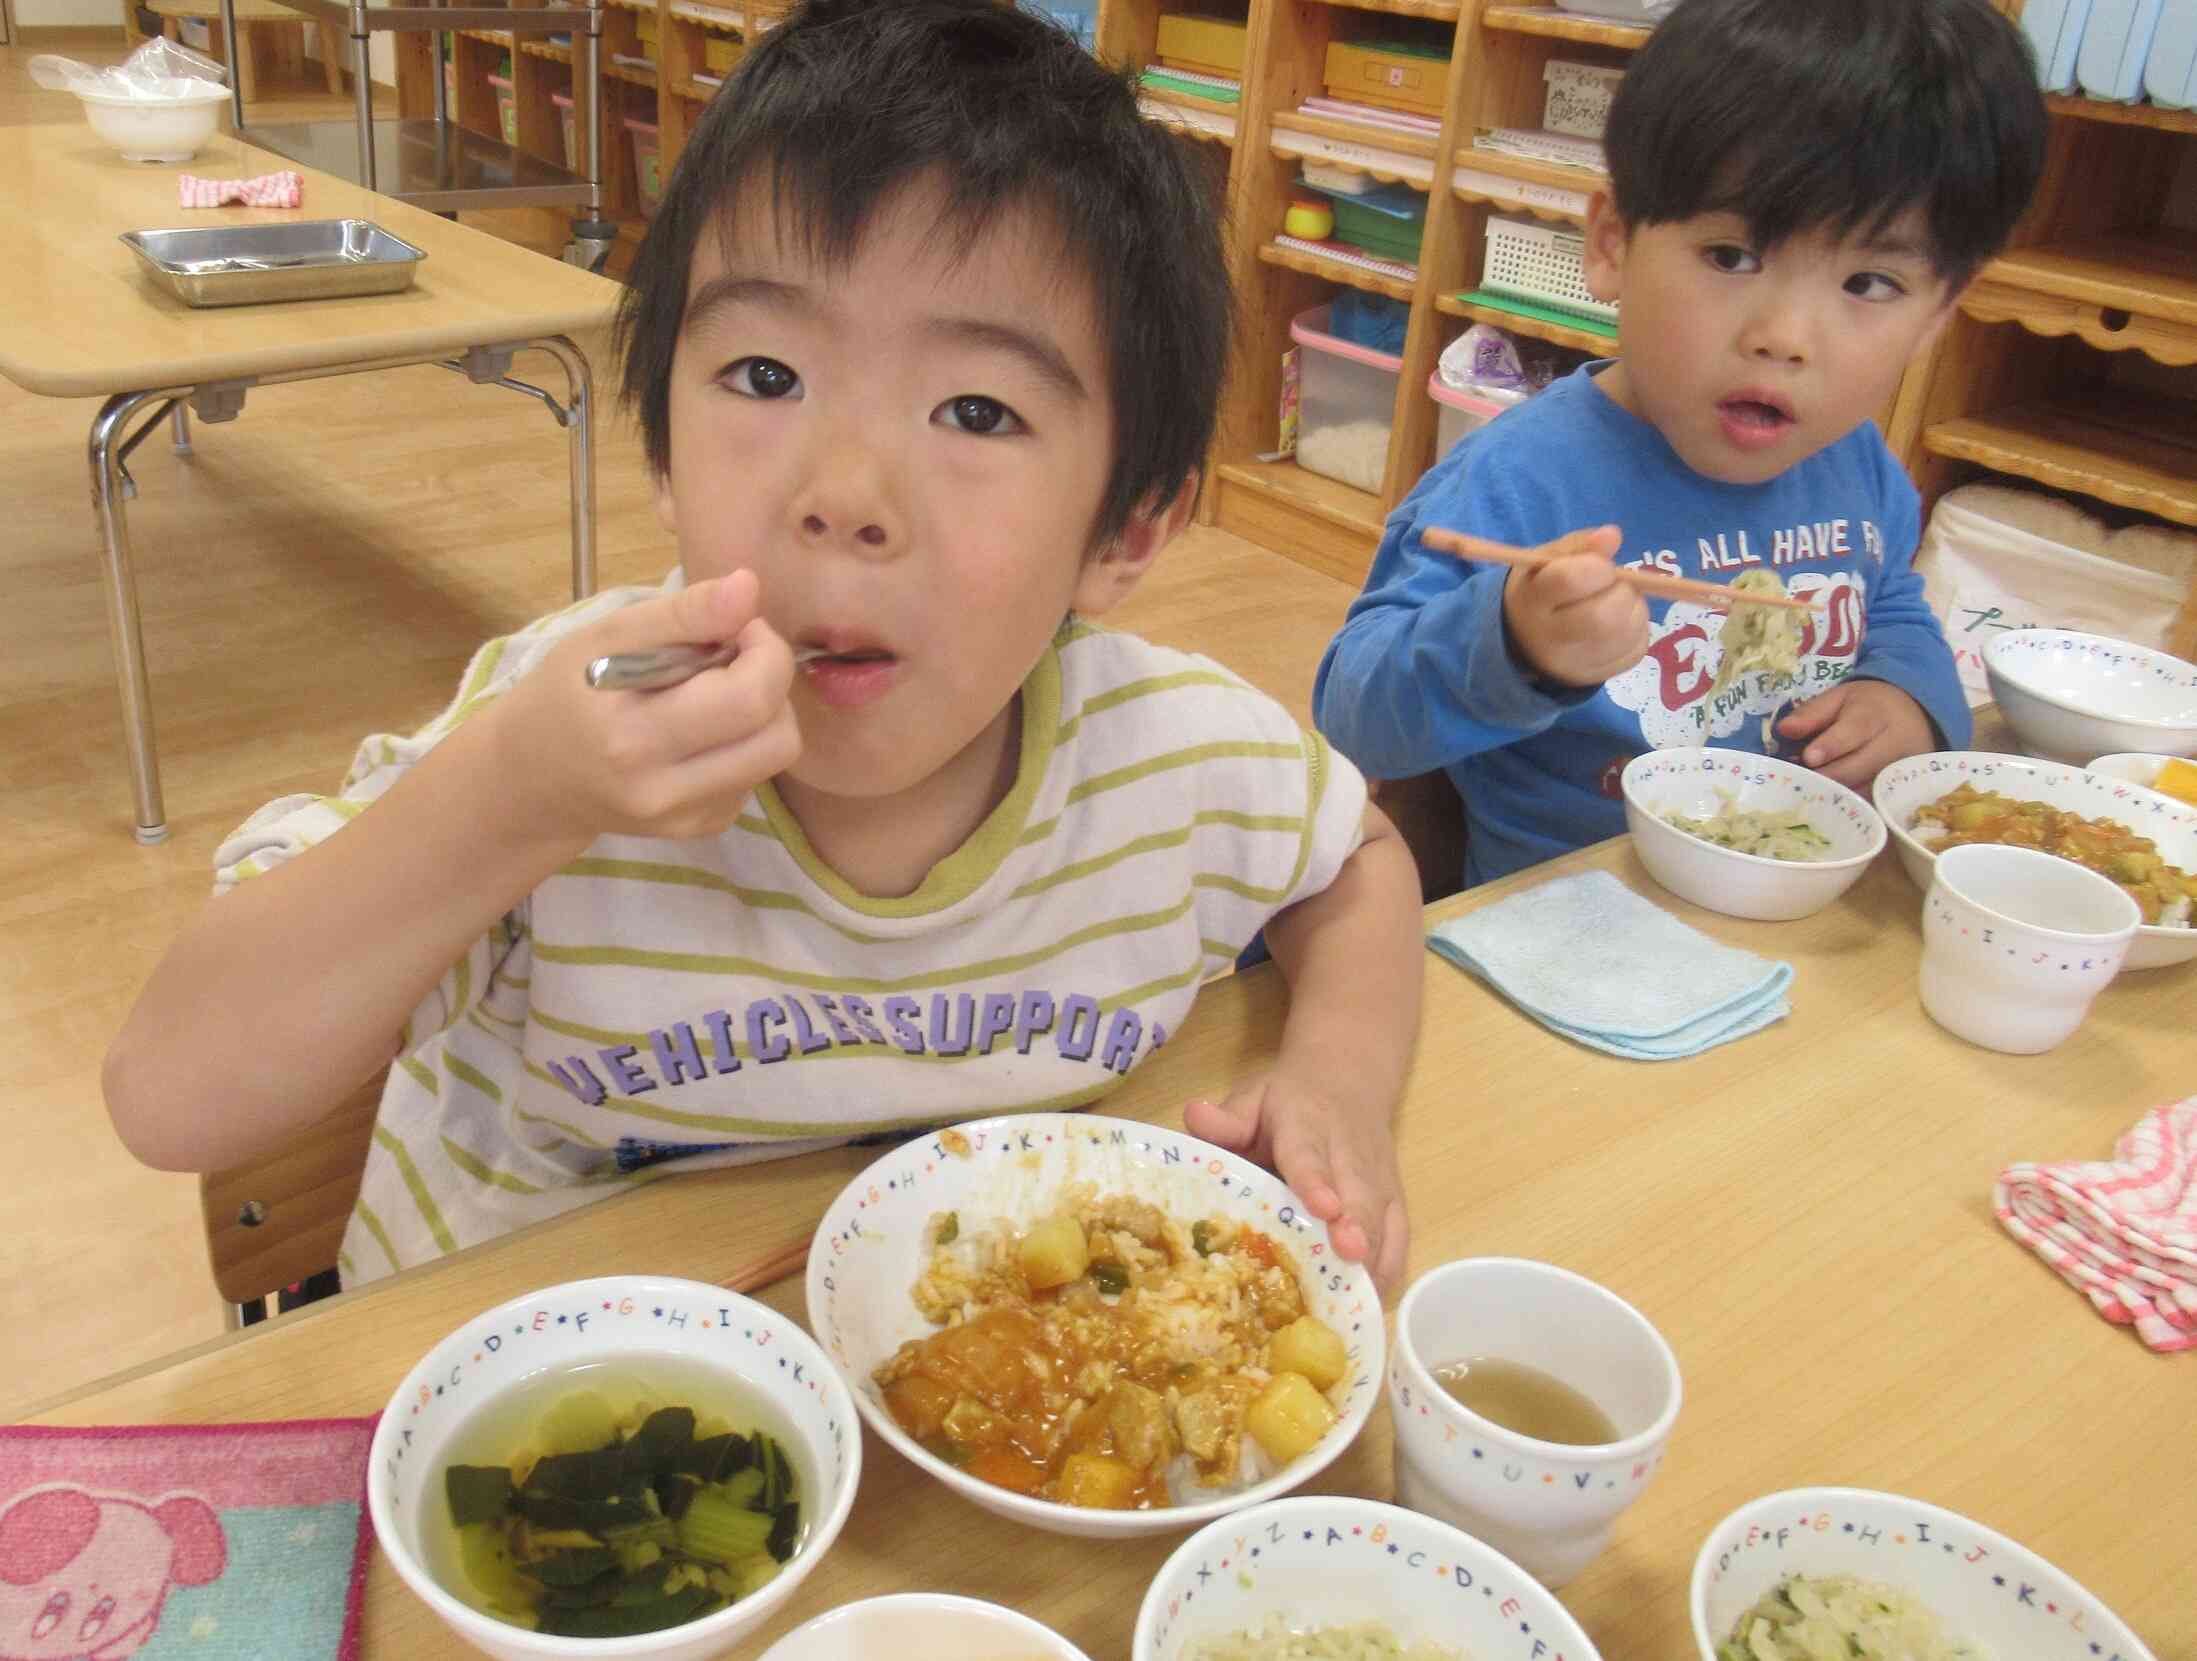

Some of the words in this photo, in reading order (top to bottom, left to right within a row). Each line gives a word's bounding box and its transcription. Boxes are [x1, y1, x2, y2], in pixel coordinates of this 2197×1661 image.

[1697, 529, 1761, 573] ALL
[1772, 518, 1851, 566] HAVE
[1714, 679, 1747, 718] FUN
[902, 1171, 915, 1188] H
[933, 1142, 947, 1161] I
[976, 1134, 987, 1151] J
[1019, 1133, 1033, 1151] K
[1110, 1129, 1127, 1144] M
[1161, 1145, 1181, 1164] N
[1207, 1159, 1223, 1176] O
[1277, 1206, 1296, 1228] Q
[1328, 1274, 1342, 1292] S
[484, 1335, 501, 1352] D
[532, 1310, 549, 1331] E
[575, 1311, 590, 1332] F
[619, 1297, 634, 1316] G
[668, 1308, 688, 1329] H
[718, 1308, 731, 1327] I
[757, 1329, 773, 1346] J
[1502, 1463, 1523, 1483] U
[1574, 1471, 1591, 1489] V
[1265, 1521, 1286, 1544] Z
[1325, 1526, 1343, 1547] A
[1369, 1523, 1388, 1545] B
[1407, 1551, 1426, 1569] C
[1455, 1565, 1473, 1588] D
[1499, 1597, 1521, 1618] E
[1531, 1638, 1547, 1660] F
[1776, 1527, 1789, 1549] F
[1857, 1523, 1883, 1546] H
[1916, 1523, 1930, 1543] I
[1963, 1543, 1990, 1564] J
[2017, 1582, 2037, 1607] K
